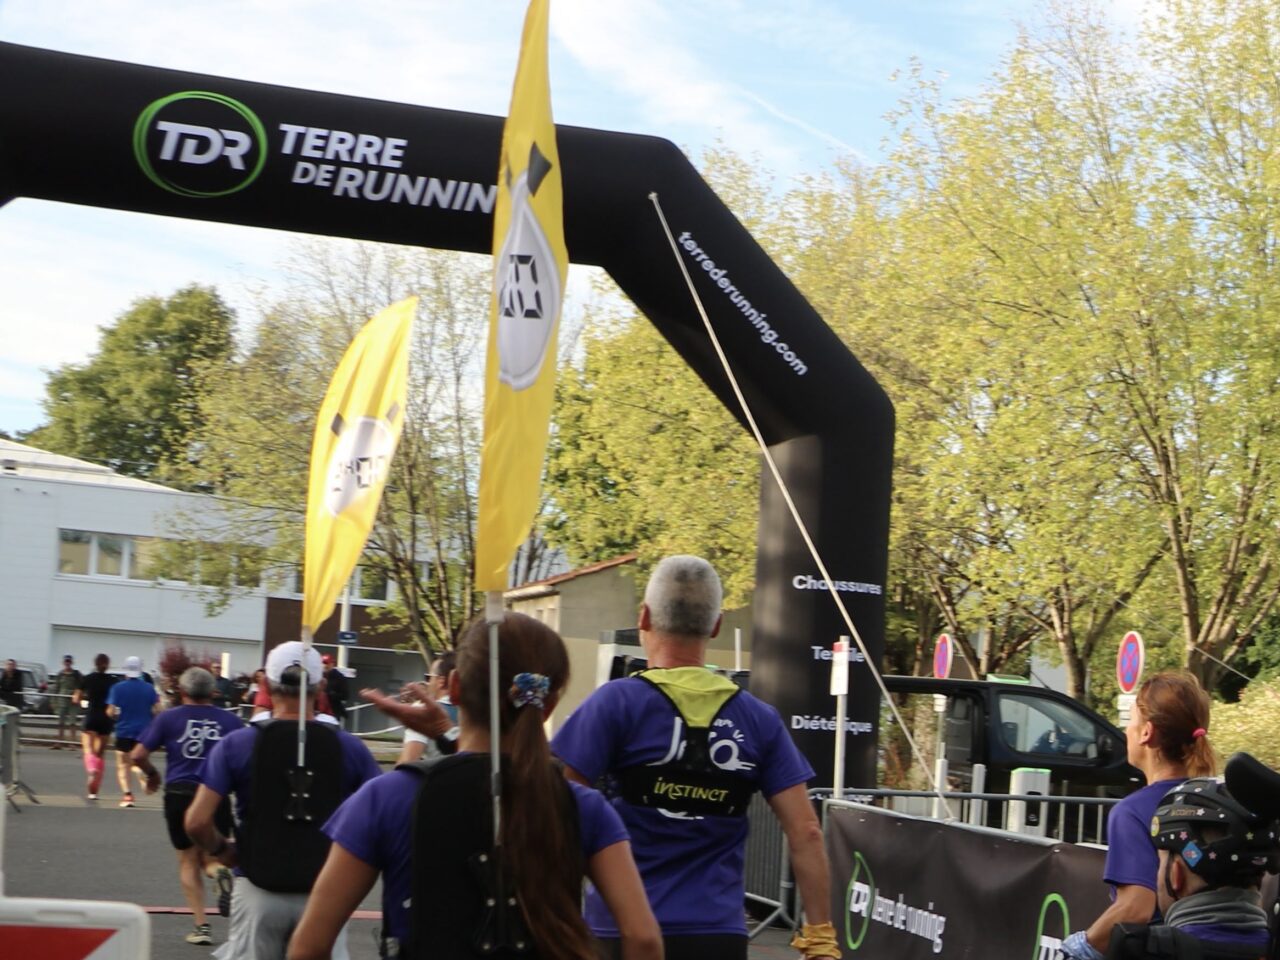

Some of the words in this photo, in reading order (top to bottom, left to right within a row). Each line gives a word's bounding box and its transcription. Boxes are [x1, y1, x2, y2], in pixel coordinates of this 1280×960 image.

[156, 120, 252, 171] TDR
[278, 123, 409, 169] TERRE
[292, 161, 337, 188] DE
[332, 171, 499, 215] RUNNIN
[678, 231, 809, 376] terrederunning.com
[810, 645, 865, 663] Teile
[791, 714, 872, 735] Diétéique
